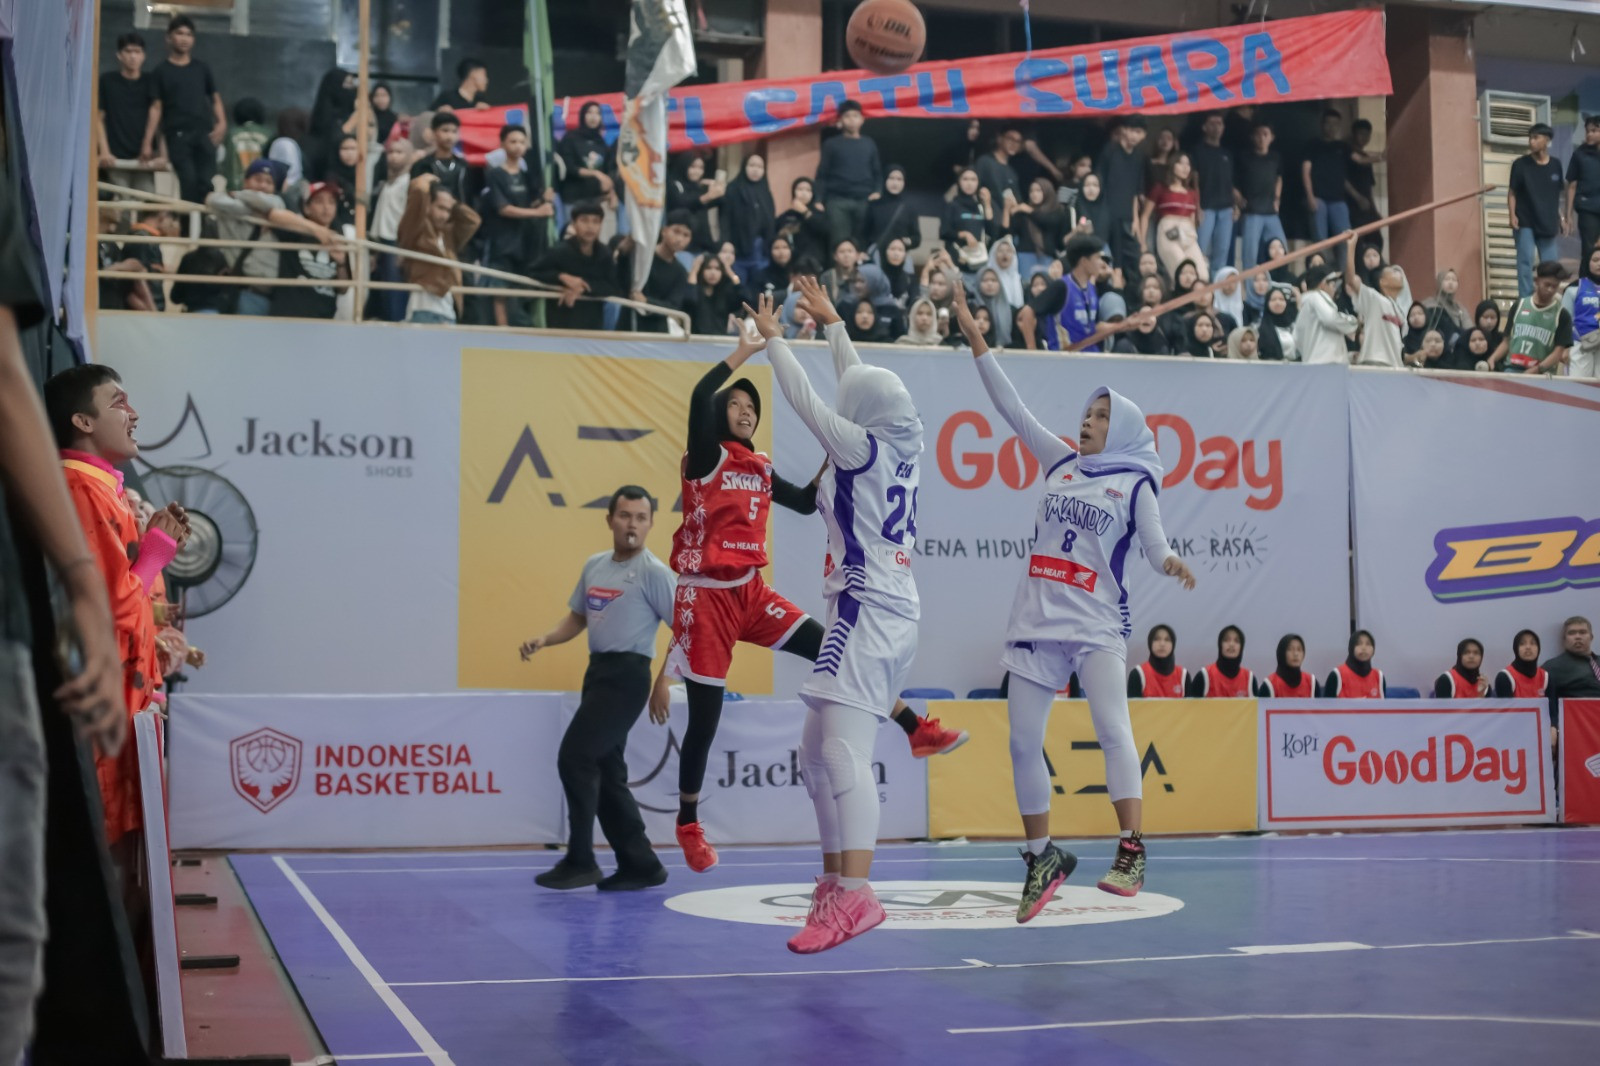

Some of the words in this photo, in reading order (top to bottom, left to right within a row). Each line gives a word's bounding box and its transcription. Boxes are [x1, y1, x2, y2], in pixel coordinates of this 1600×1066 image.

[744, 69, 970, 133] SATU
[1014, 32, 1291, 113] SUARA
[1520, 340, 1533, 354] 17
[236, 417, 415, 460] Jackson
[365, 465, 412, 478] SHOES
[749, 496, 760, 520] 5
[1044, 493, 1114, 536] MANDU
[722, 541, 736, 549] One
[1061, 529, 1077, 553] 8
[1210, 537, 1255, 557] RASA
[1031, 565, 1043, 575] One
[765, 602, 787, 619] 5
[316, 744, 472, 768] INDONESIA
[718, 750, 889, 788] Jackn
[315, 771, 502, 796] BASKETBALL
